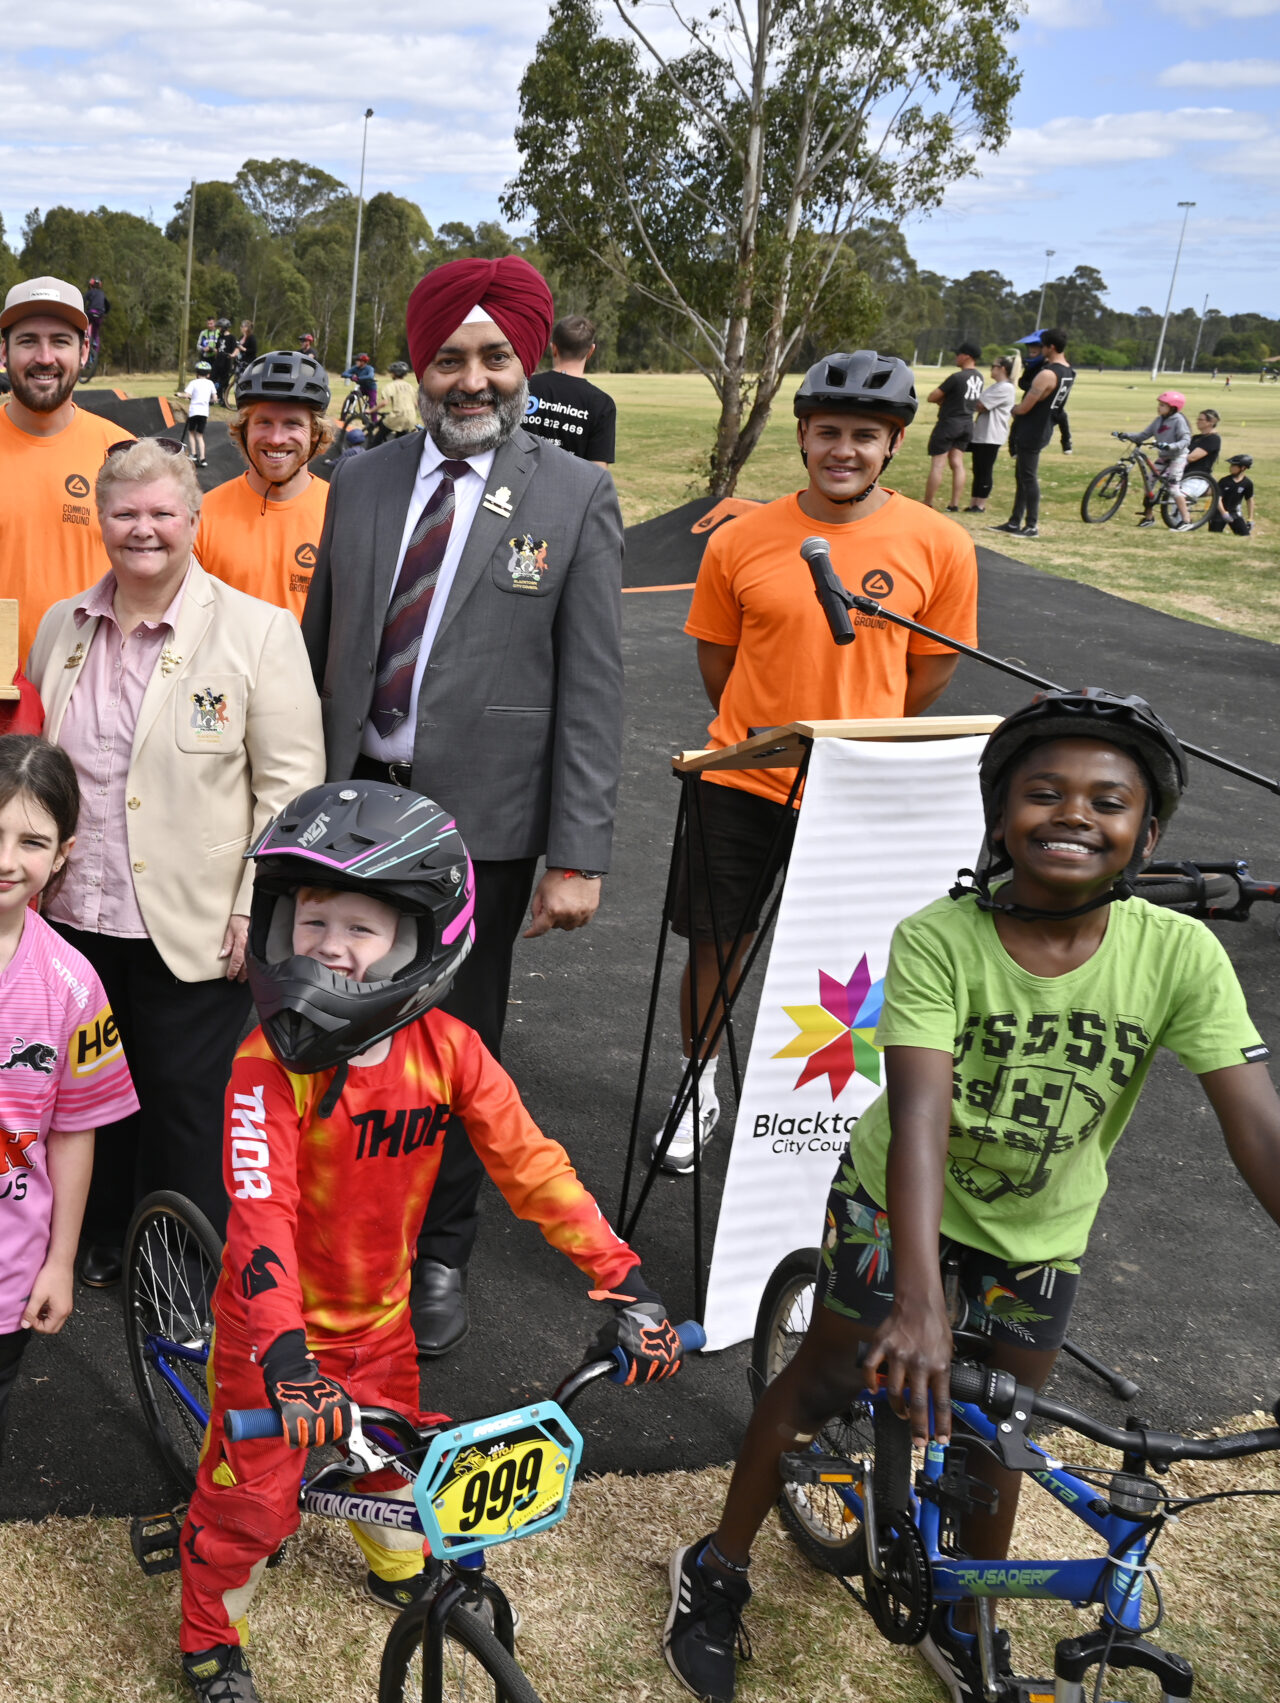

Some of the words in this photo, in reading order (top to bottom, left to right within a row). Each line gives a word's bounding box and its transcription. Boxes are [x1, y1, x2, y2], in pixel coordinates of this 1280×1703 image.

[539, 398, 589, 420] brainiact
[544, 418, 560, 429] 272
[562, 423, 583, 435] 469
[62, 504, 90, 516] COMMON
[62, 513, 89, 526] GROUND
[854, 616, 888, 630] GROUND
[77, 1014, 120, 1064] He
[230, 1085, 272, 1199] THOR
[772, 1139, 806, 1155] City
[459, 1447, 543, 1532] 999
[305, 1490, 417, 1530] MONGOOSE
[958, 1569, 1048, 1585] CRUSADER
